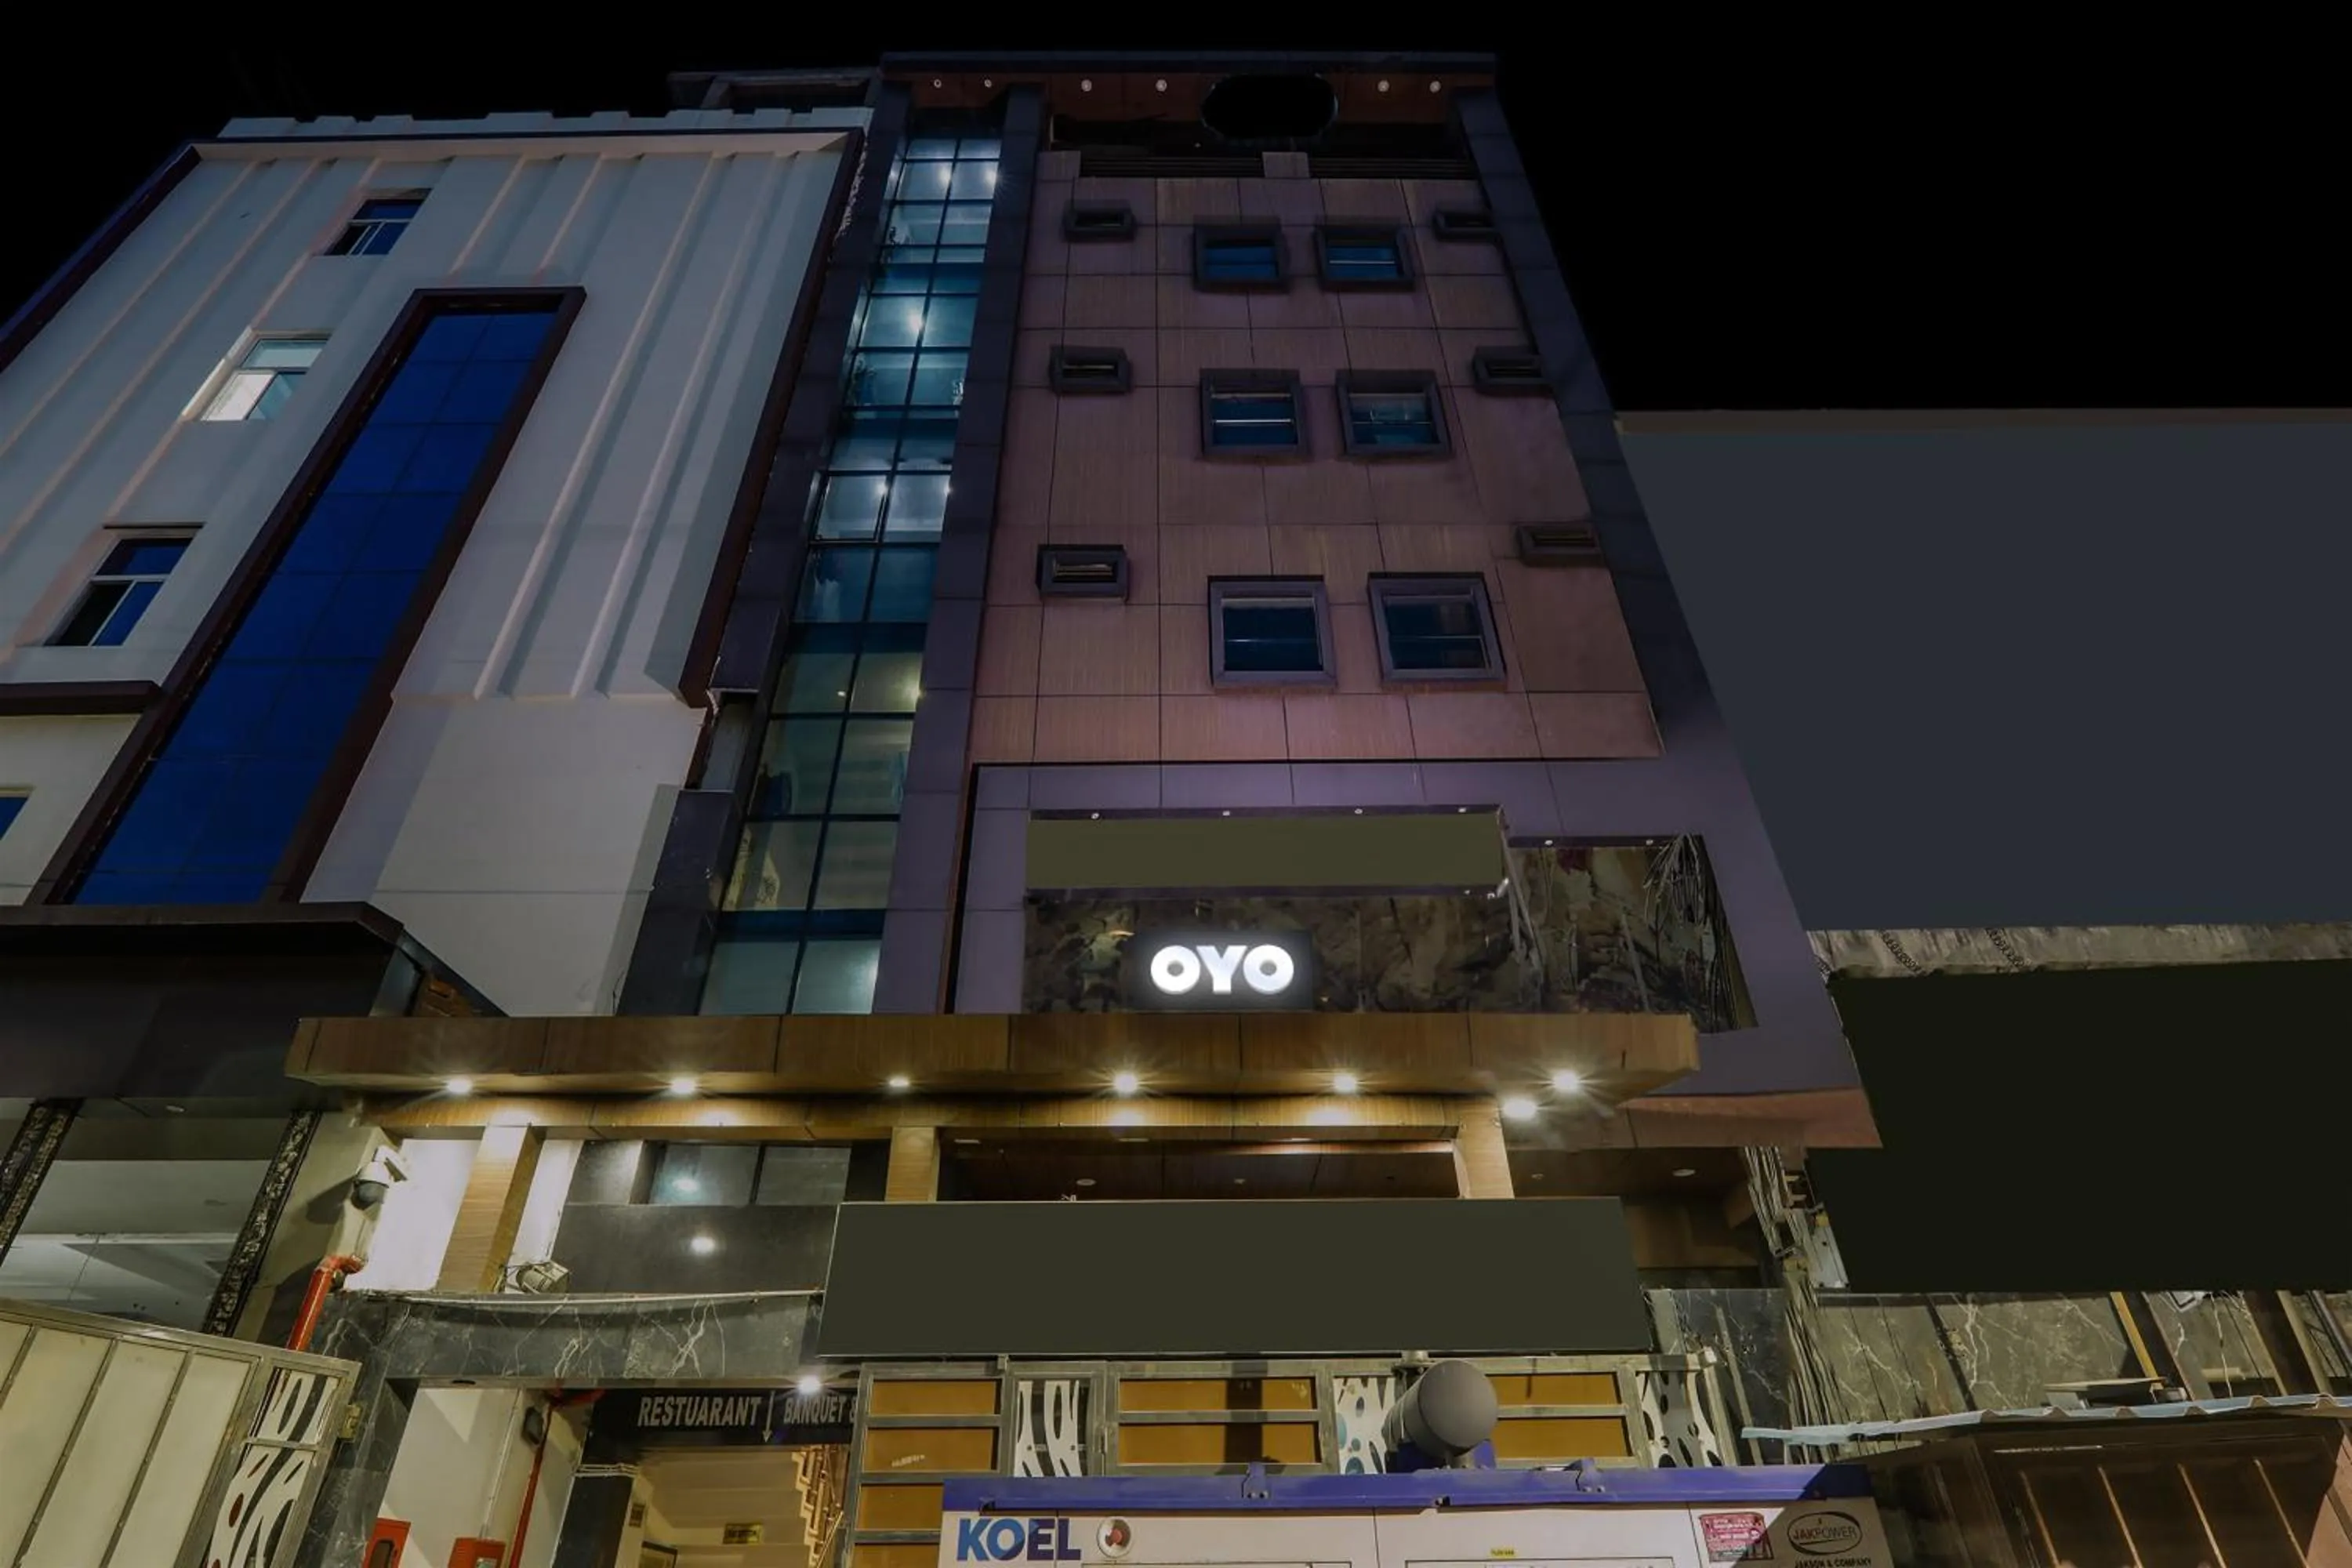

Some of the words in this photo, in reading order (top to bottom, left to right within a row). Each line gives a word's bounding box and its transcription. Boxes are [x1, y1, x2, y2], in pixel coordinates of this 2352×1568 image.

[1150, 944, 1294, 994] OYO
[637, 1396, 762, 1427] RESTUARANT
[784, 1396, 847, 1424] BANQUET
[956, 1518, 1081, 1561] KOEL
[1793, 1526, 1857, 1540] JAKPOWER
